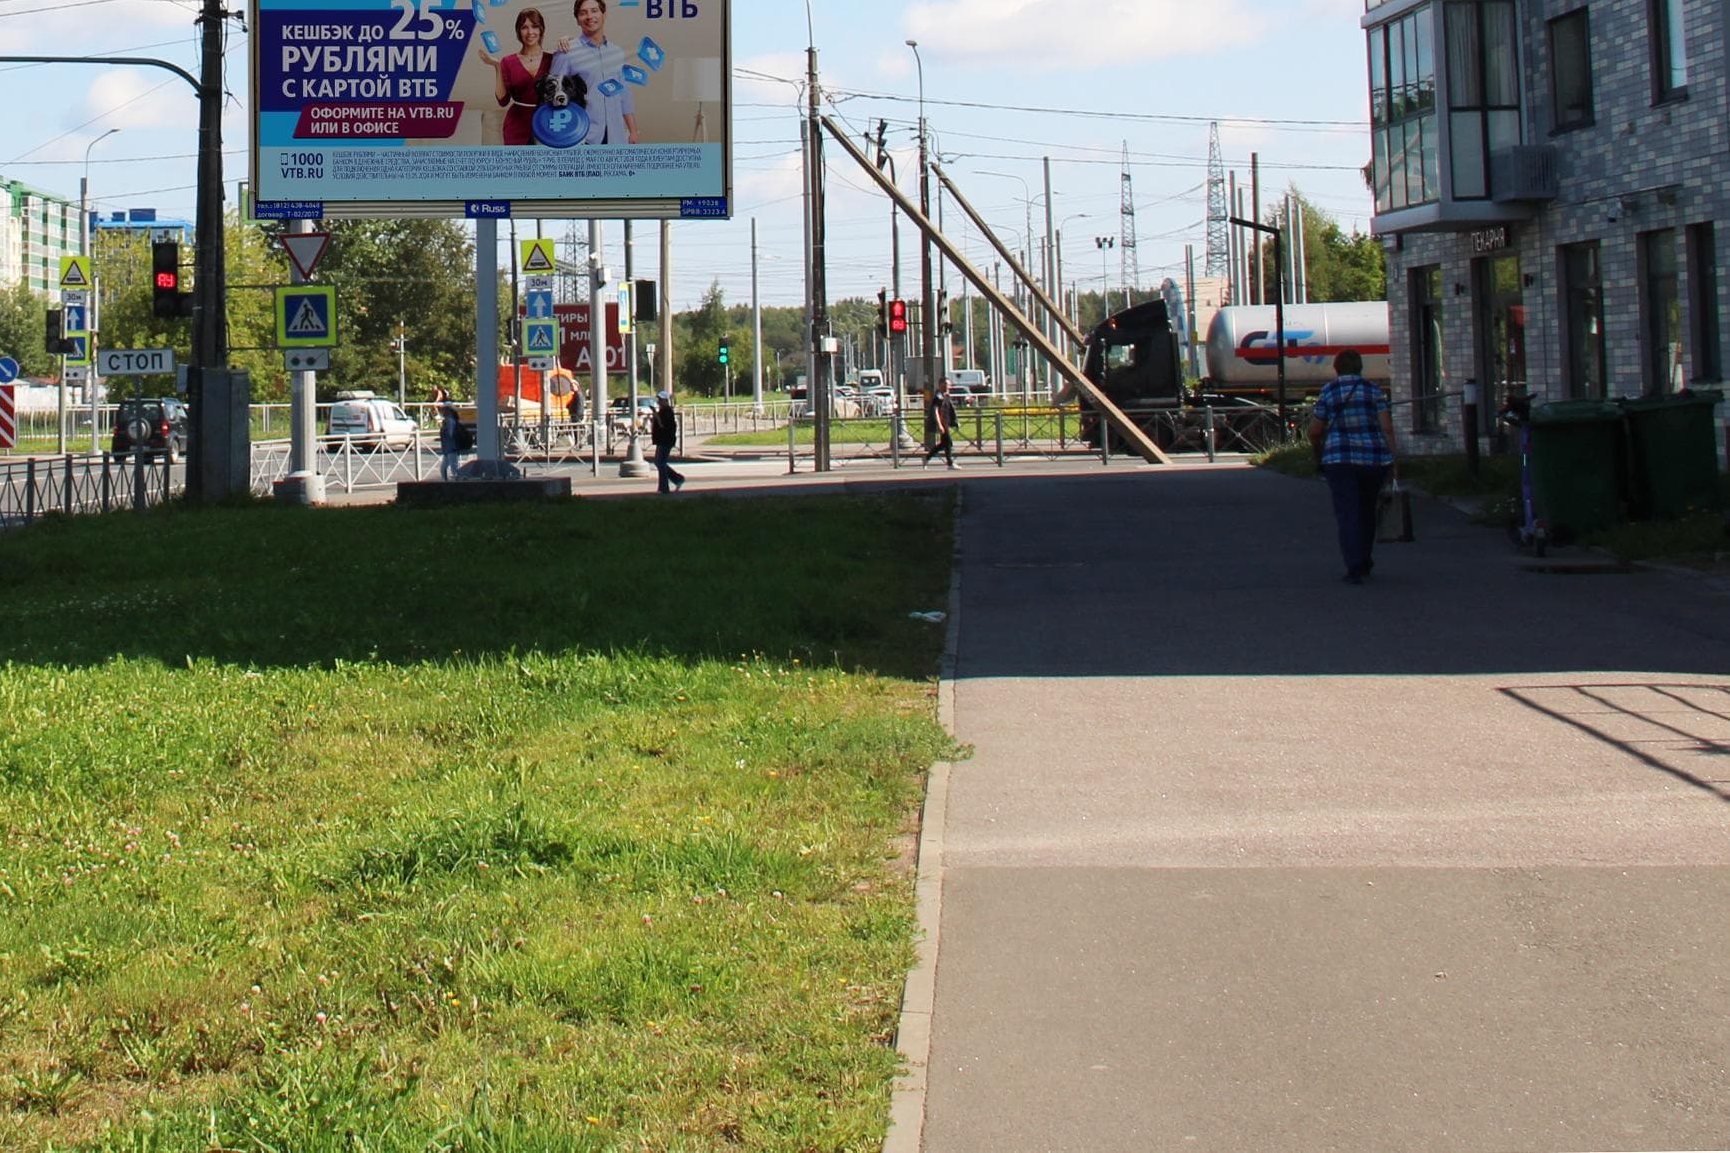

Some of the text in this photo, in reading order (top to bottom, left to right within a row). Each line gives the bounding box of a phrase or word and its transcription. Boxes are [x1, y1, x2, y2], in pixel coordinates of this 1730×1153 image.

[282, 25, 354, 40] КЕШБЭК
[358, 25, 384, 43] ДО
[282, 46, 438, 72] РУБЛЯМИ
[282, 74, 438, 97] С КАРТОЙ ВТБ
[311, 107, 454, 119] ОФОРМИТЕ НА VTB.RU
[311, 122, 399, 134] ИЛИ В ОФИСЕ
[291, 153, 324, 166] 1000
[281, 168, 324, 179] VTB.RU
[481, 204, 506, 213] Russ
[108, 352, 163, 371] СТОП
